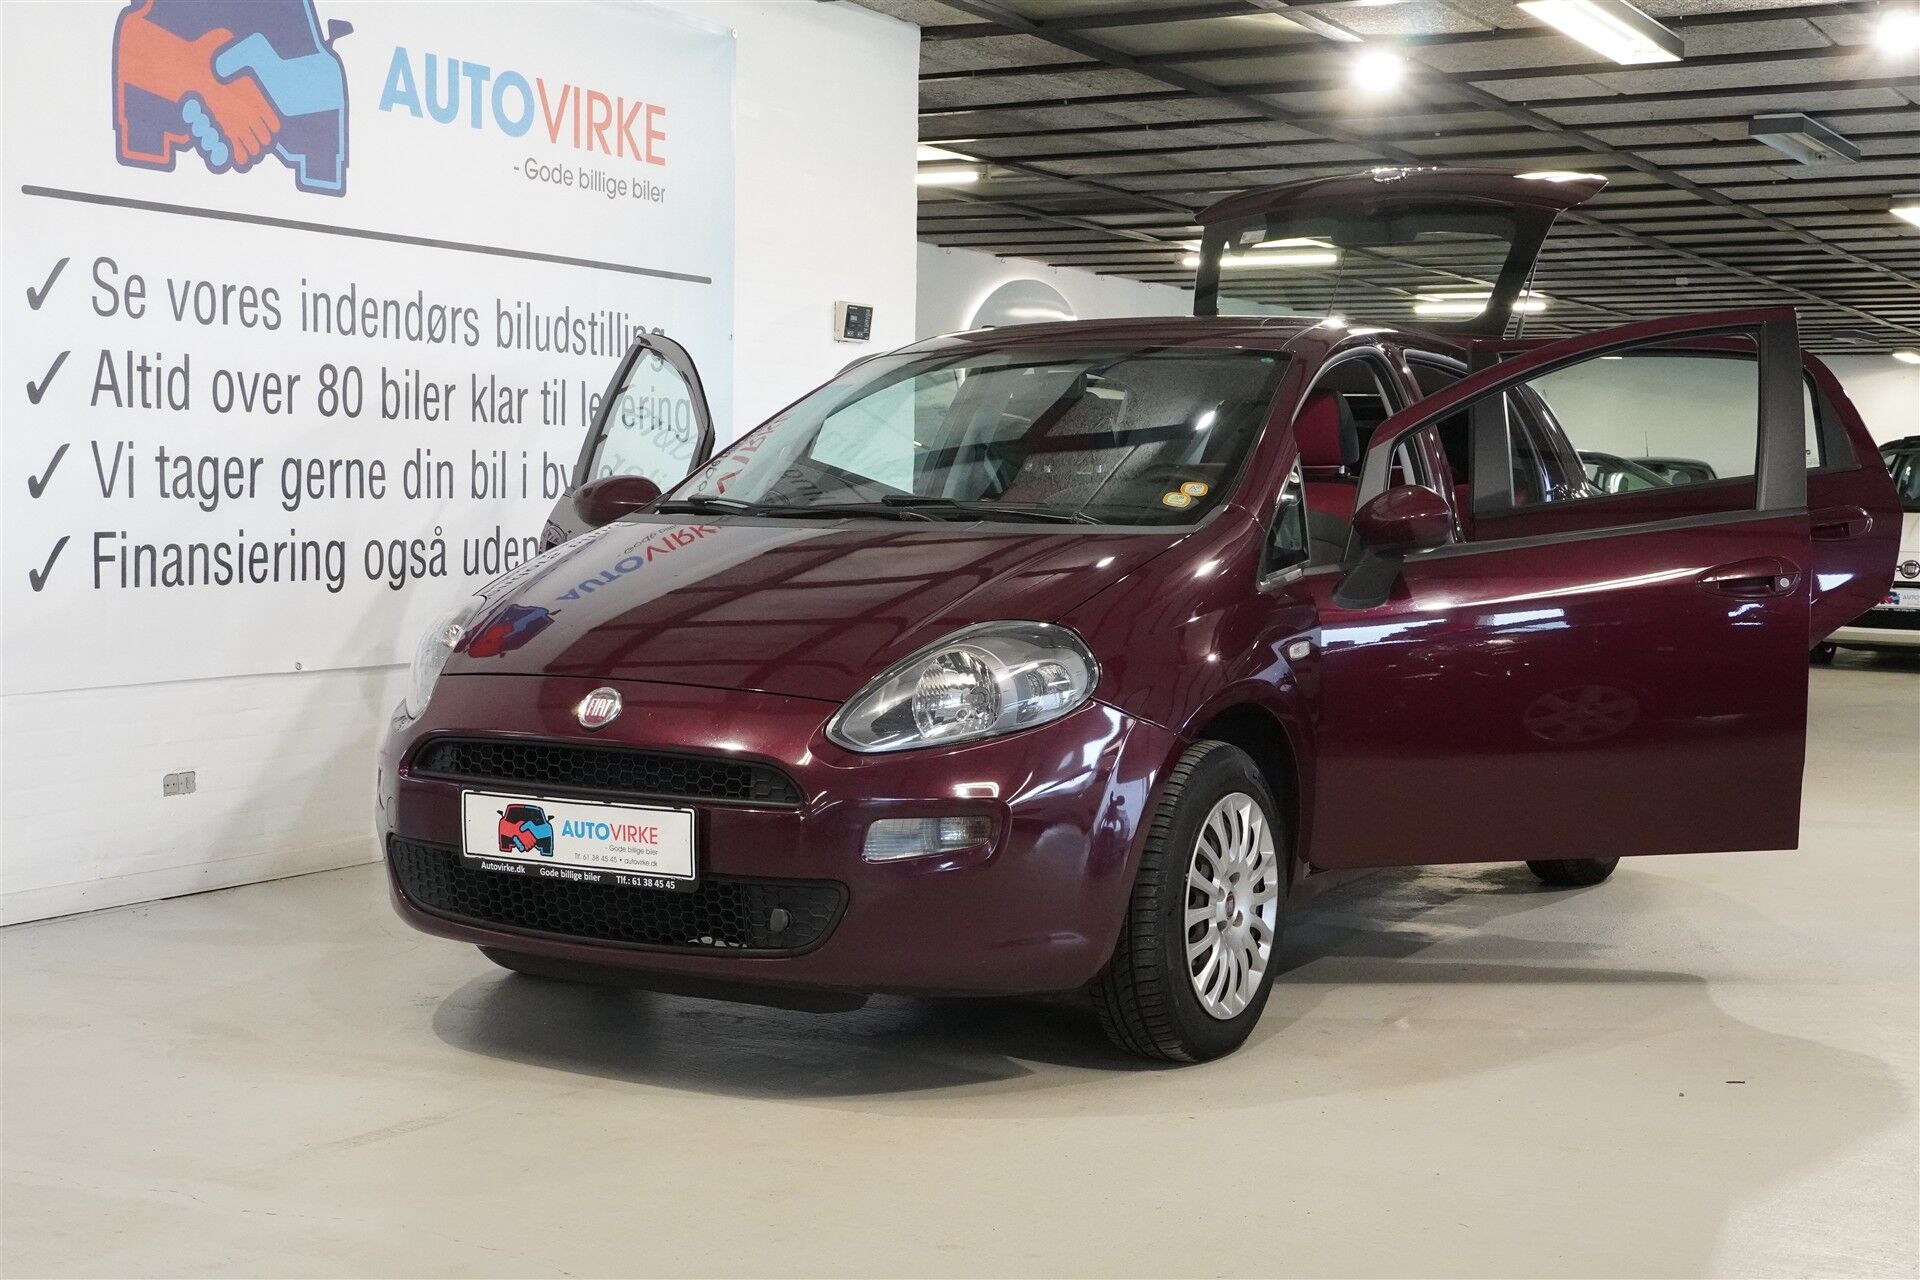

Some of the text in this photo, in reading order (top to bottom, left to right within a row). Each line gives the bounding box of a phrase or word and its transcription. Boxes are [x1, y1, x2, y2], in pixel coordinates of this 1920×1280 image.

[379, 46, 666, 166] AUTOVIRKE
[525, 158, 573, 186] Gode
[579, 167, 627, 200] billige
[633, 177, 666, 204] biler
[92, 256, 146, 319] Se
[166, 278, 281, 331] vores
[301, 278, 480, 347] indendørs
[90, 349, 690, 443] Altid over 80 biler klar til leering
[91, 440, 135, 498] Vi
[155, 446, 264, 512] tager
[281, 457, 386, 512] gerne
[403, 448, 454, 499] din
[471, 449, 506, 499] bil
[522, 451, 527, 499] i
[94, 528, 345, 593] Finansiering
[364, 526, 447, 591] også
[585, 698, 615, 717] FIAT
[561, 819, 659, 845] AUTOVIRKE
[609, 844, 659, 856] Gode billige biler
[481, 861, 676, 890] Autovirke.dk Gode billige biler Tlf.: 61 38 45 45
[582, 853, 590, 861] 61
[591, 854, 600, 862] 38
[609, 856, 618, 864] 45
